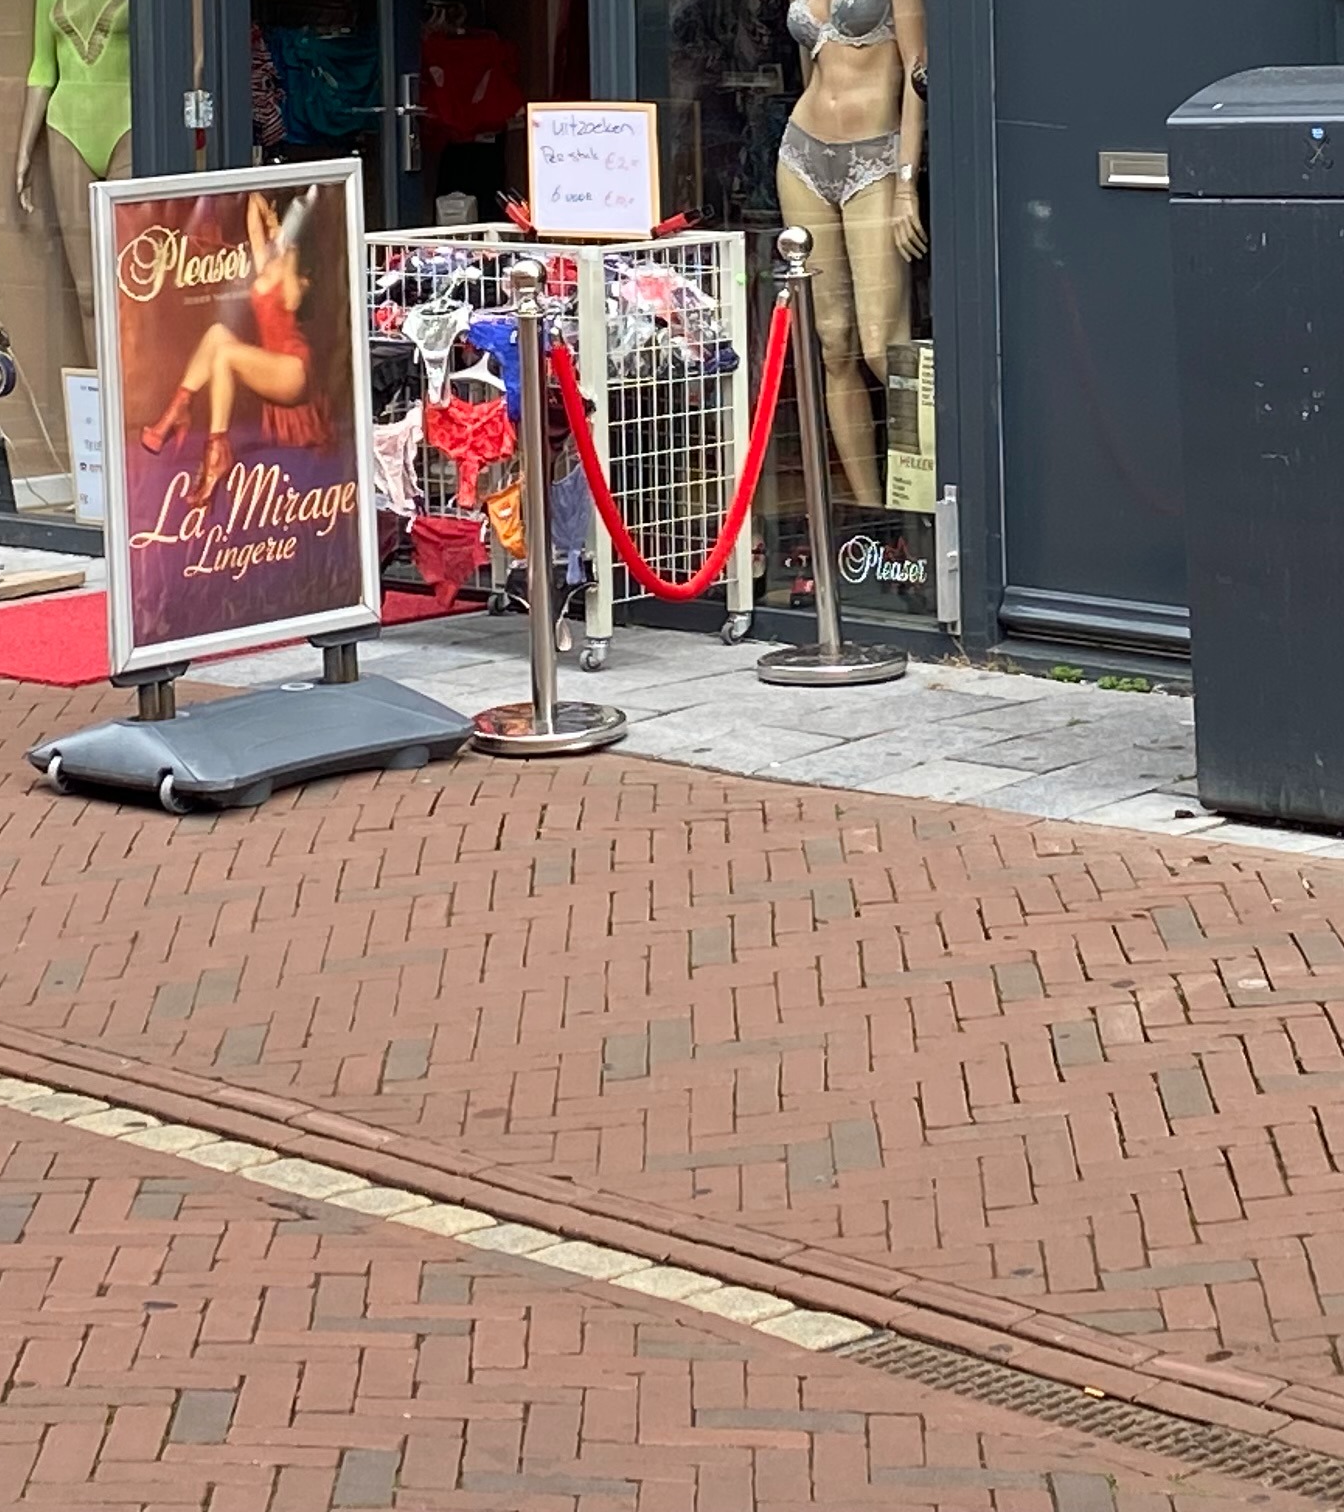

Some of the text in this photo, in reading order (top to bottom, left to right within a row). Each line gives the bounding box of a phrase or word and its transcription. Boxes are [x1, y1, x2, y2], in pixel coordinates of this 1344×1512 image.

[116, 224, 253, 303] Pleaser
[129, 462, 358, 549] La Mirage
[183, 524, 298, 580] Lingerie
[837, 534, 929, 584] Pleaser
